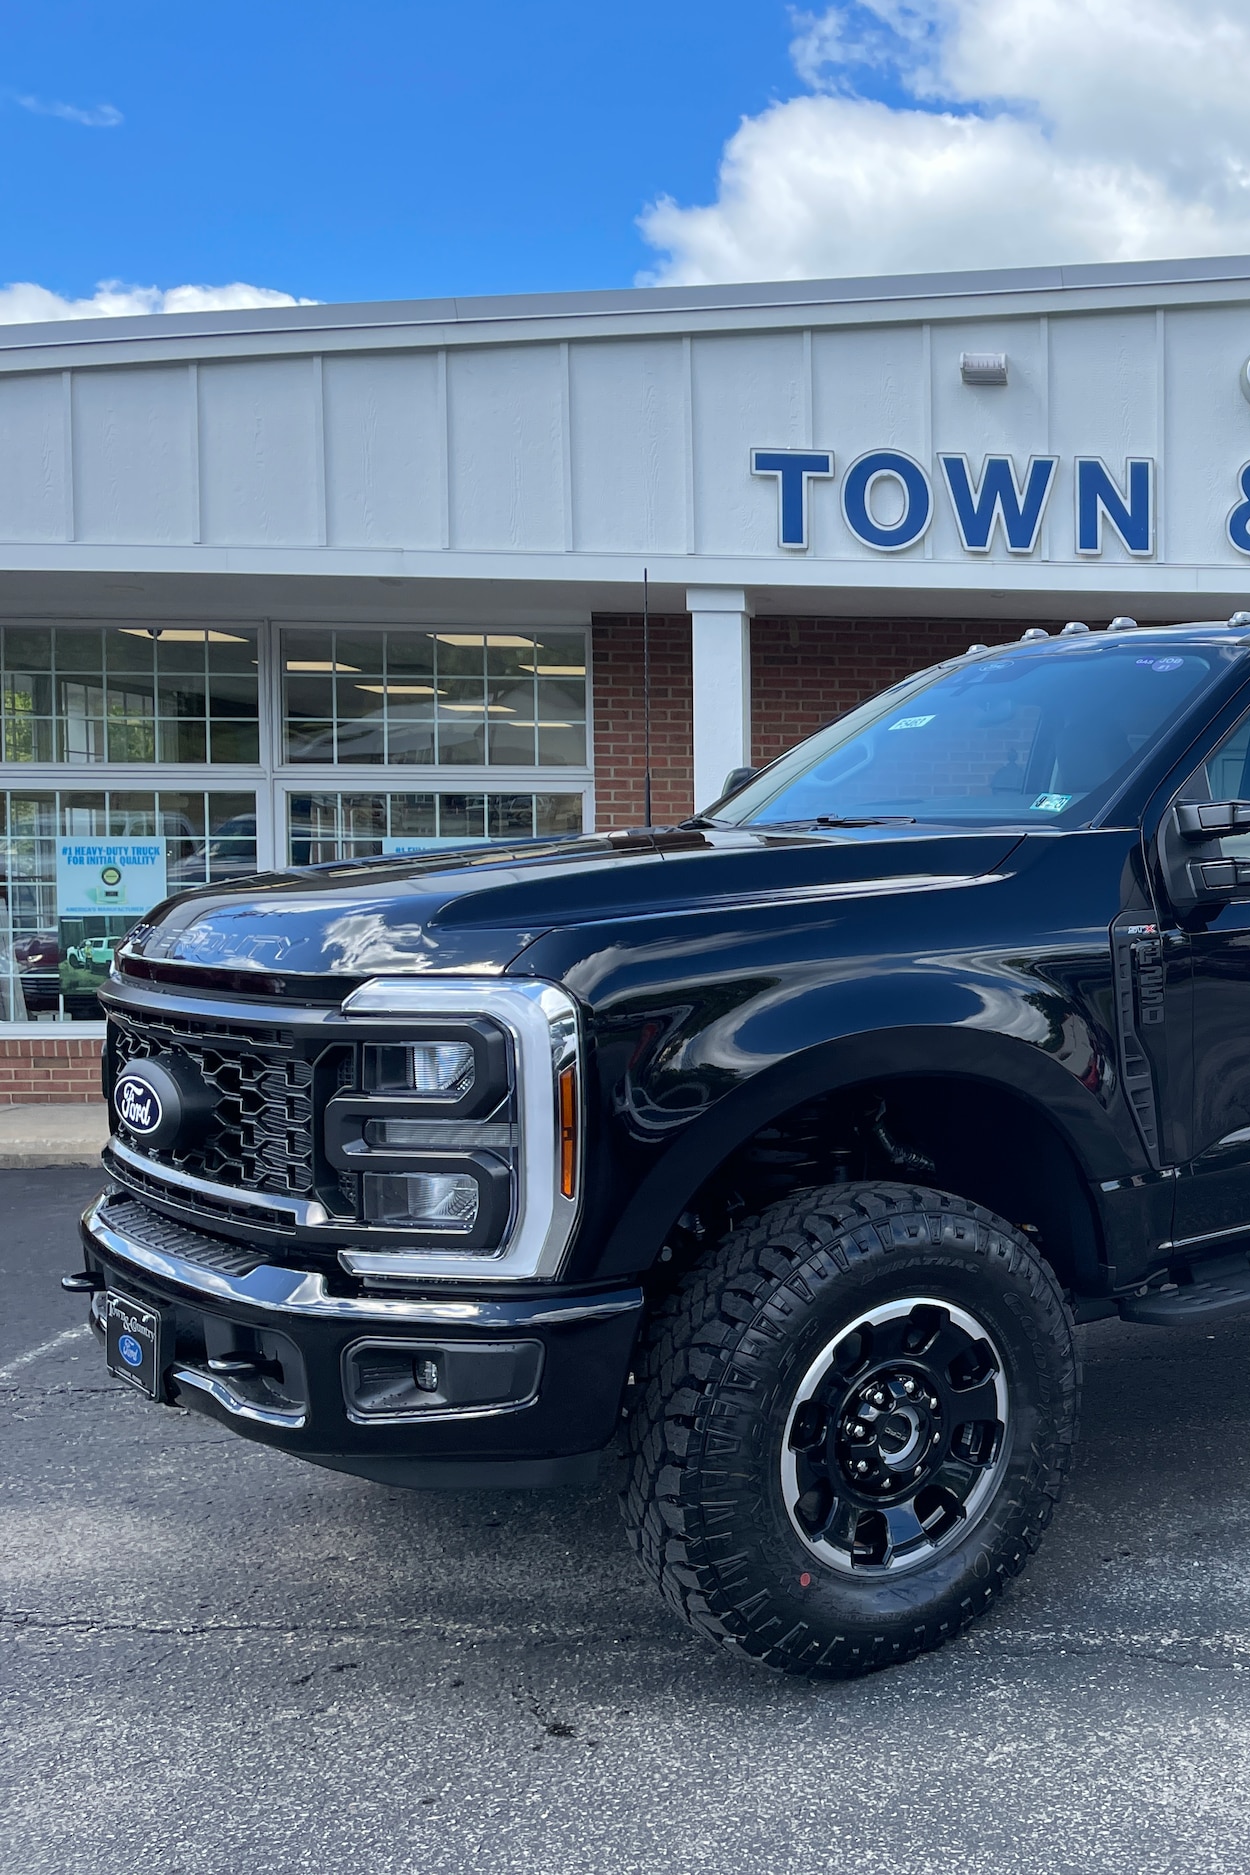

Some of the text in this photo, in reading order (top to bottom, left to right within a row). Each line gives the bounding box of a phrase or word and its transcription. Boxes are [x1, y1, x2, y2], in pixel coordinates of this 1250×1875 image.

[750, 448, 1154, 556] TOWN
[62, 846, 160, 856] #1 HEAVY-DUTY TRUCK
[67, 856, 155, 866] FOR INITIAL QUALITY
[121, 1082, 151, 1126] Ford
[107, 1300, 127, 1320] Town
[130, 1317, 156, 1342] Country
[122, 1338, 138, 1362] Ford
